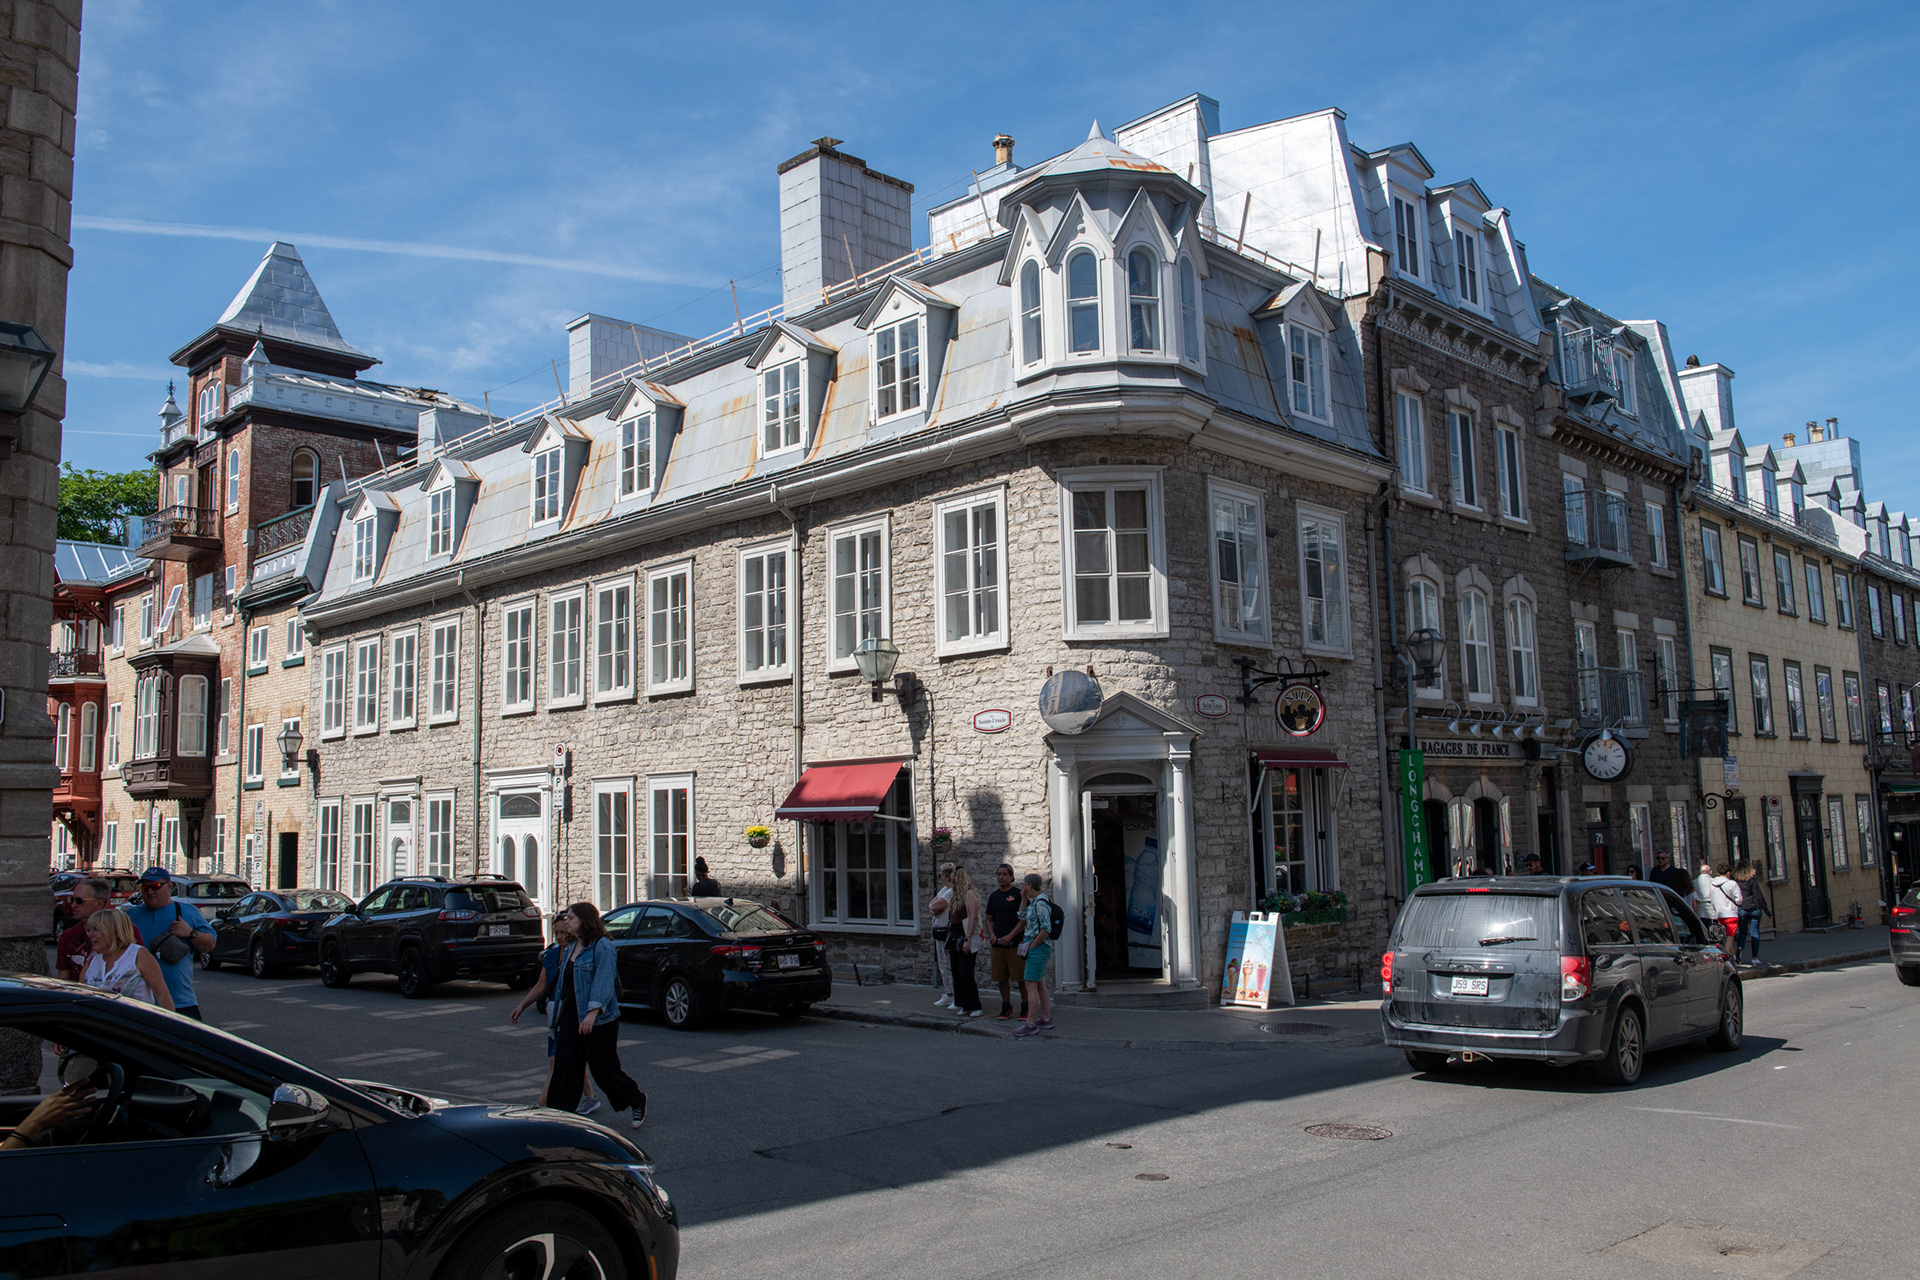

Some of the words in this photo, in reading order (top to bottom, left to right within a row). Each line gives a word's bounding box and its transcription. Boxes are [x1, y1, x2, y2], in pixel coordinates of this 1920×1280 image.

[1283, 690, 1314, 705] NILI
[978, 716, 1006, 724] Sainte-Ursule
[1421, 741, 1464, 756] BAGAGES
[1467, 742, 1479, 756] DE
[1481, 743, 1510, 757] FRANCE
[1587, 740, 1623, 759] BAGAGES
[1597, 754, 1608, 762] DE
[1589, 765, 1620, 777] FRANCE
[556, 777, 561, 787] P
[257, 802, 262, 810] P
[1125, 818, 1149, 831] eska
[1408, 754, 1425, 886] LONGCHAMP
[256, 835, 261, 843] P
[1595, 832, 1604, 844] 72
[255, 862, 260, 870] P
[1131, 905, 1149, 918] eska
[1452, 979, 1468, 990] J59
[1471, 980, 1487, 991] SRS
